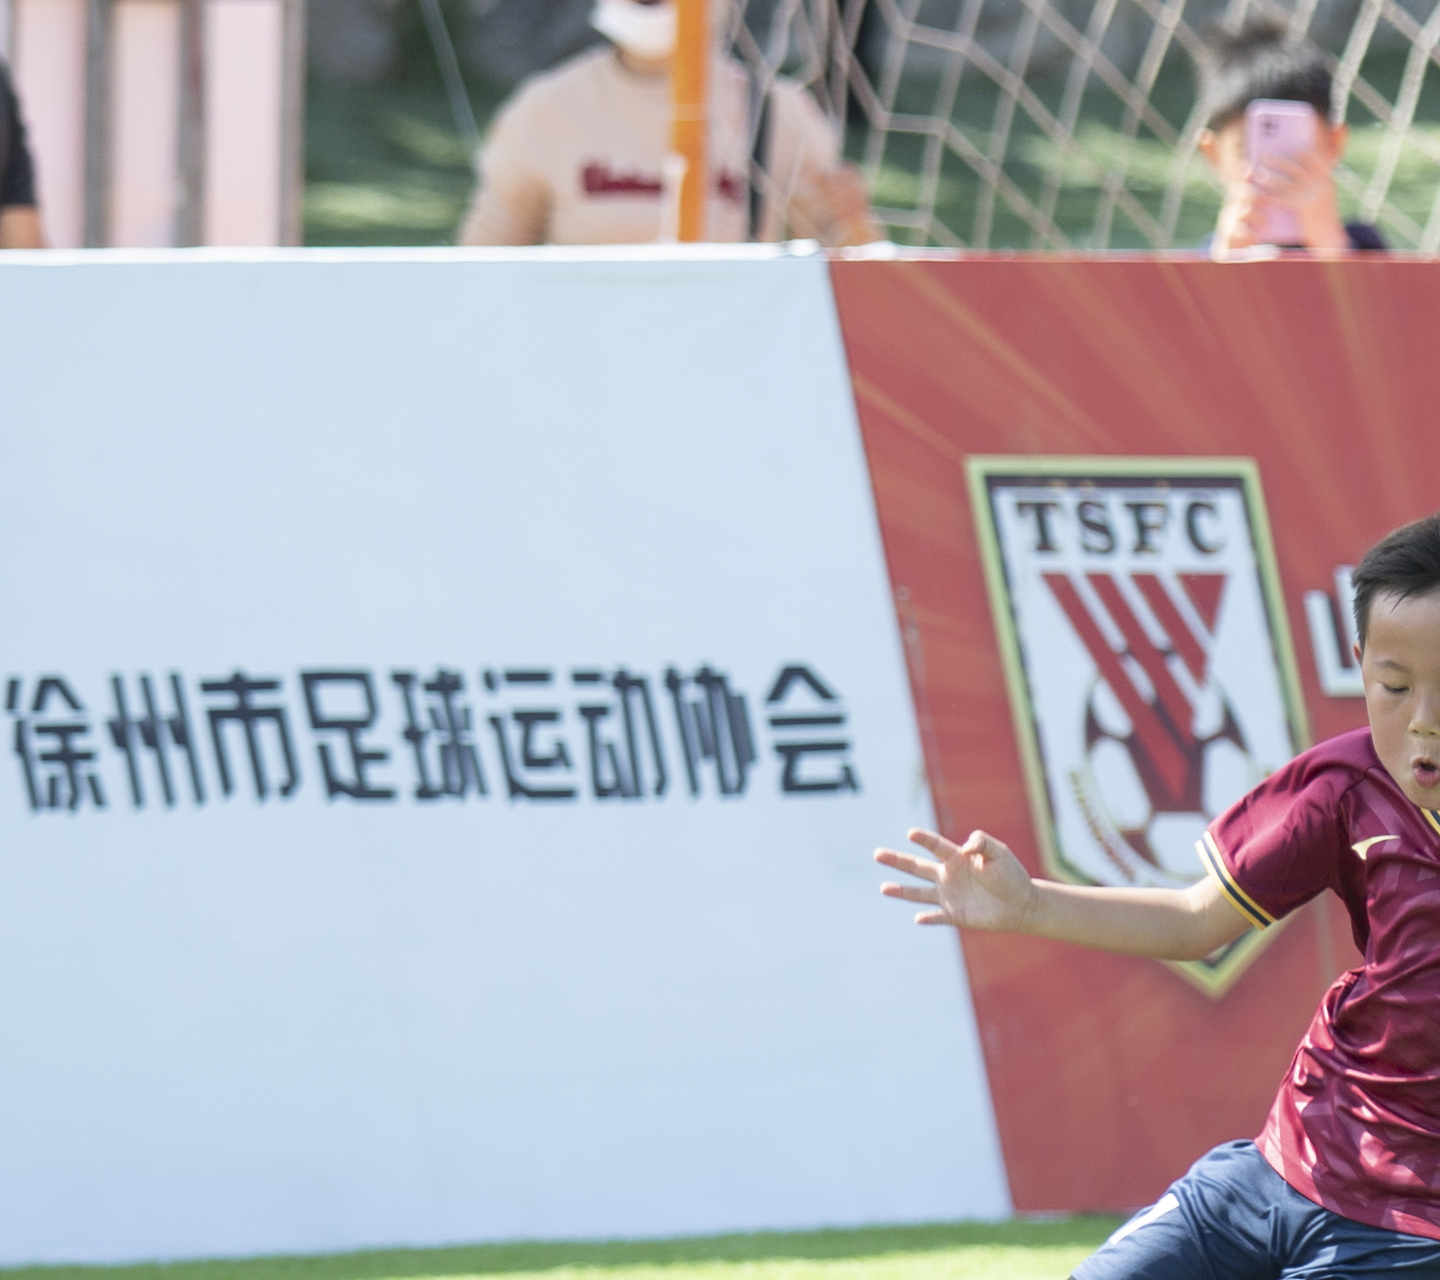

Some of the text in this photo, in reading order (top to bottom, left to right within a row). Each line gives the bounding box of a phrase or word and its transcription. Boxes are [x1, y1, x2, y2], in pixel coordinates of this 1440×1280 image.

[1016, 501, 1226, 556] TSFC
[5, 663, 862, 814] 徐州市足球运动协会
